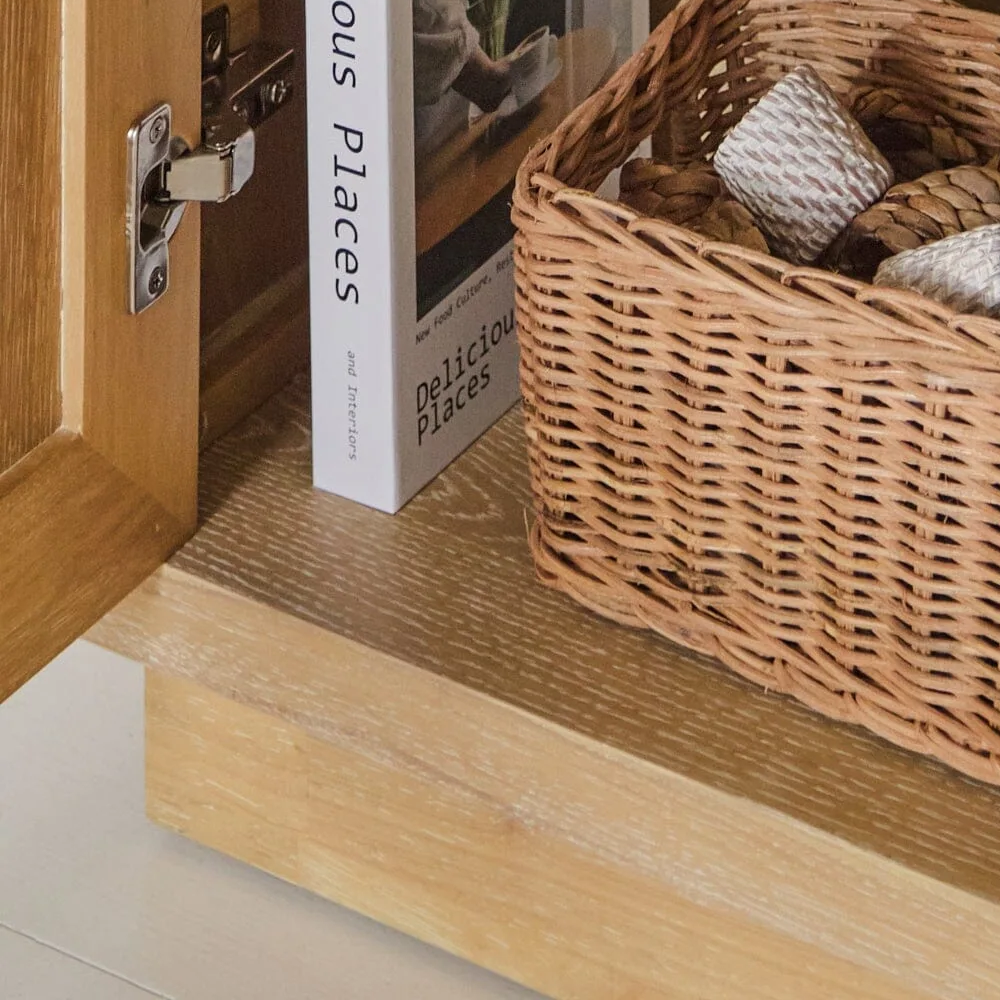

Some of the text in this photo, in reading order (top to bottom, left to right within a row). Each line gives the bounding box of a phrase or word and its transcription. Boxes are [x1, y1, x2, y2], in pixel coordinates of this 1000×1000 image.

[333, 123, 366, 304] Places
[415, 274, 492, 345] New Food Culture,
[416, 308, 514, 414] Deliciou
[347, 350, 358, 461] and Interiors
[418, 363, 490, 446] Places
